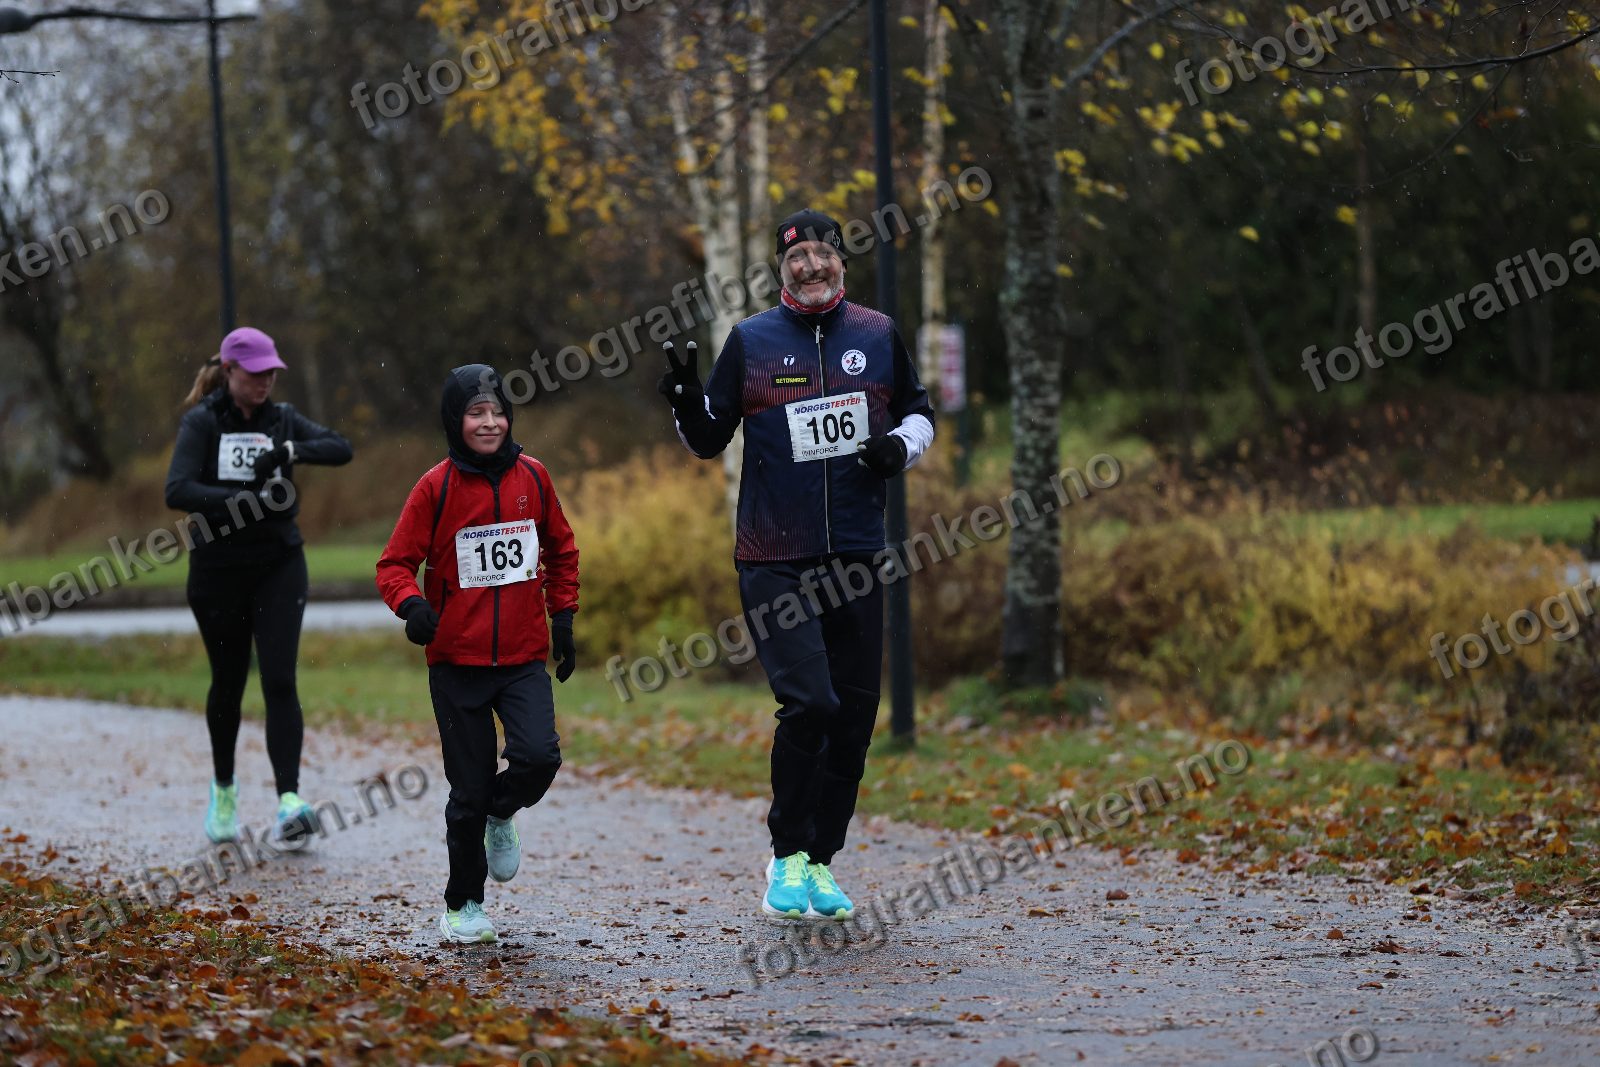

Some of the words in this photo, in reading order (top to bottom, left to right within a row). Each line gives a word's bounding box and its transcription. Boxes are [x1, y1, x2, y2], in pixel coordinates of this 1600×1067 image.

[794, 397, 860, 415] NORGESTESTEN
[806, 410, 855, 445] 106
[232, 447, 267, 468] 35
[462, 525, 531, 539] NORGESTESTEN
[474, 538, 524, 571] 163
